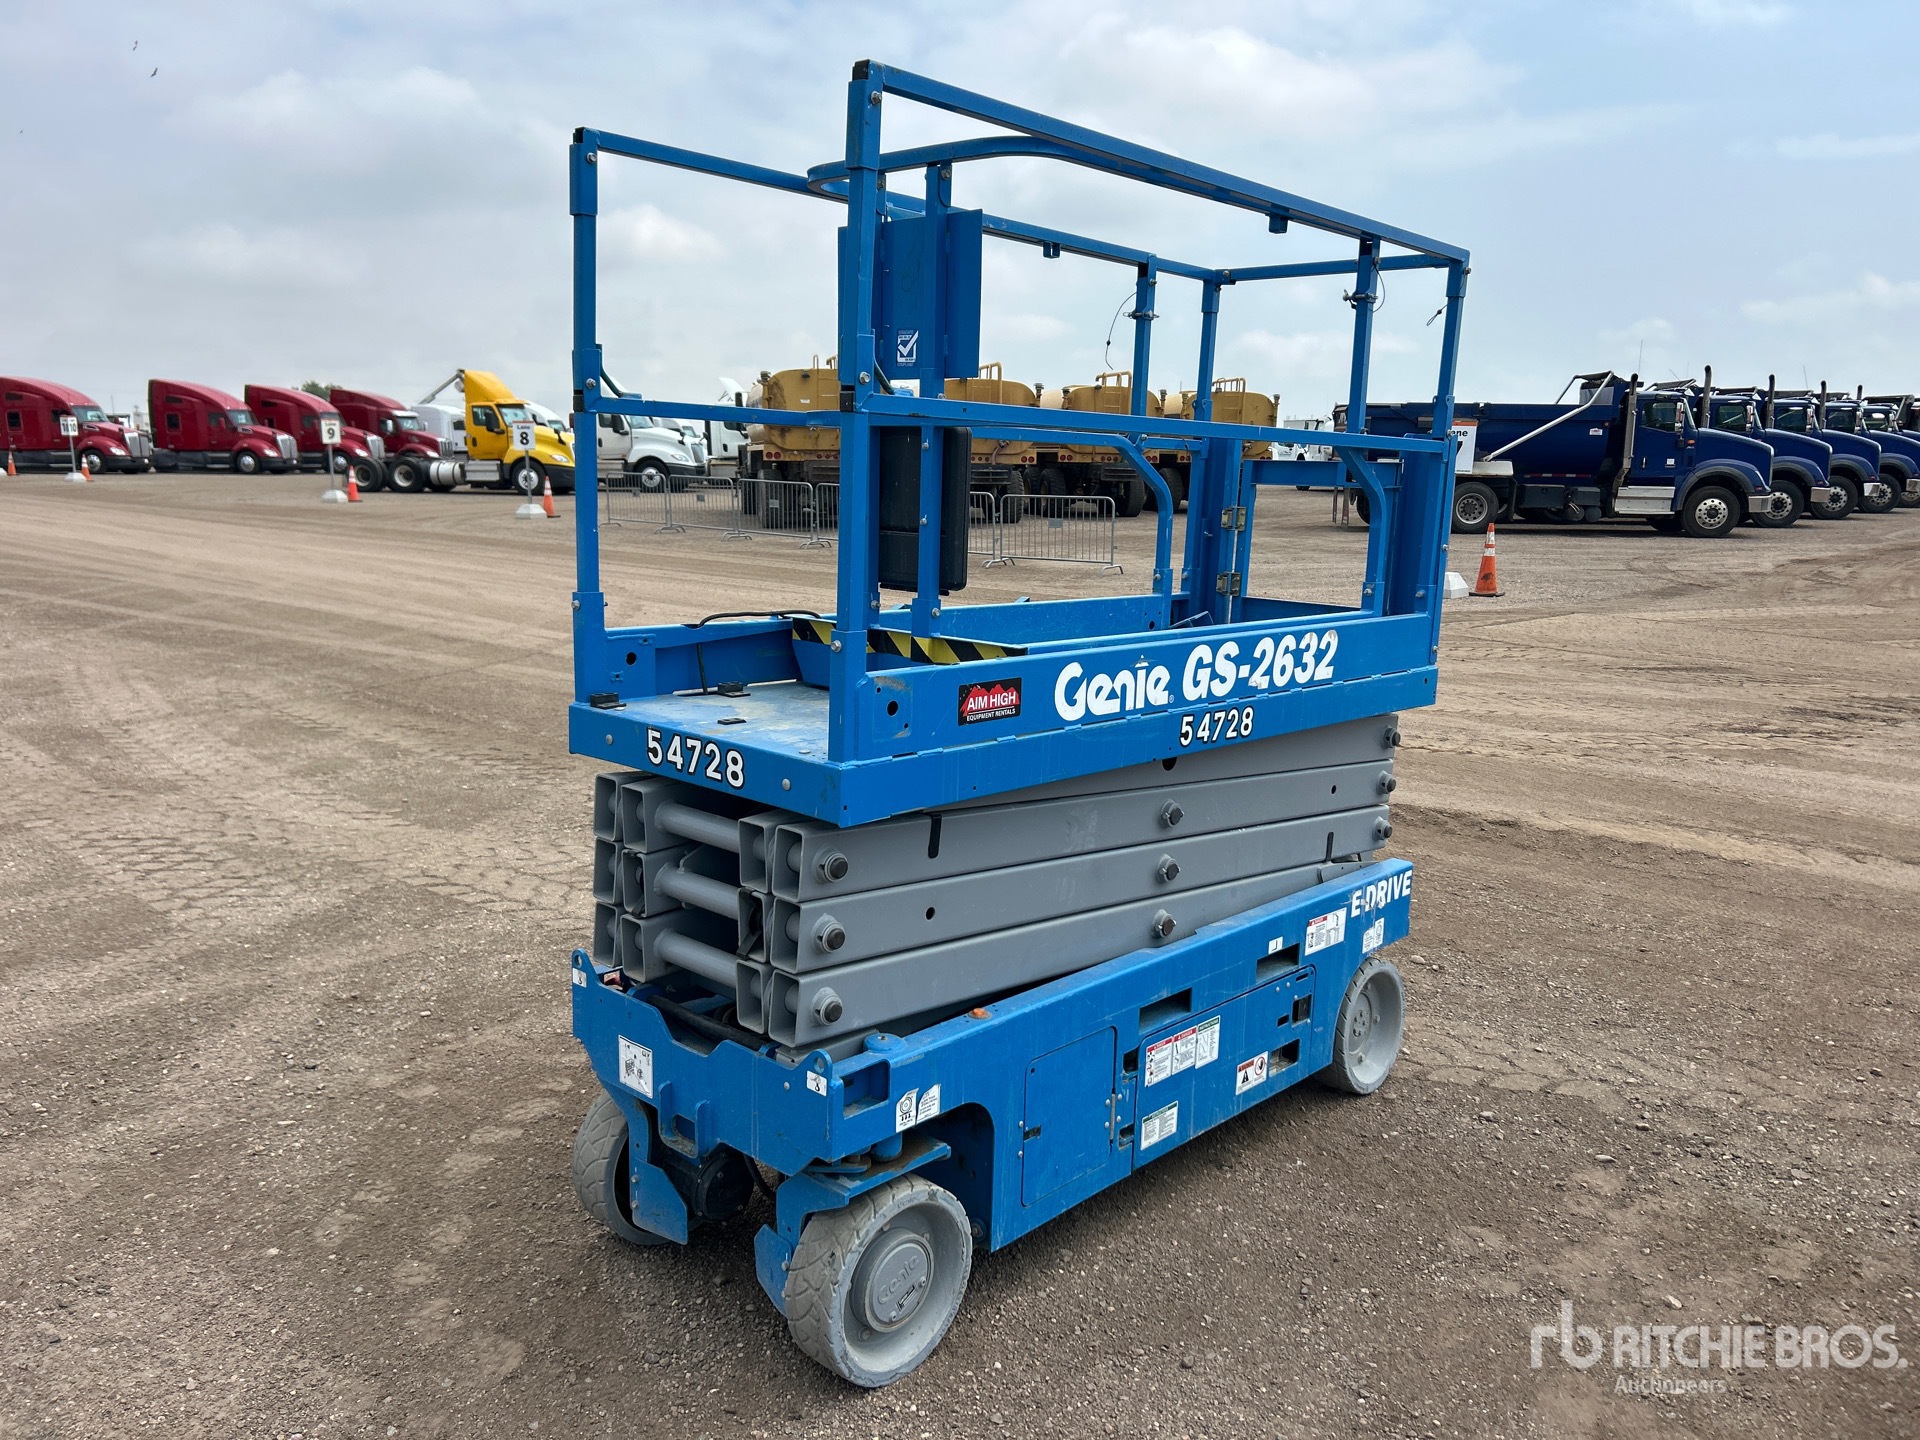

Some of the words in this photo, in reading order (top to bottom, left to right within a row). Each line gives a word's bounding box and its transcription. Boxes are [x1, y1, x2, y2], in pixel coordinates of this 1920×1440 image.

[327, 427, 335, 439] 9
[520, 431, 529, 445] 8
[1054, 655, 1170, 721] Genie
[1182, 630, 1339, 701] GS-2632
[967, 695, 988, 711] AIM
[990, 691, 1016, 708] HIGH
[967, 712, 995, 722] EQUIPMENT
[995, 708, 1016, 717] RENTALS
[1179, 705, 1254, 747] 54728
[647, 728, 744, 788] 54728
[878, 1255, 920, 1304] Genie
